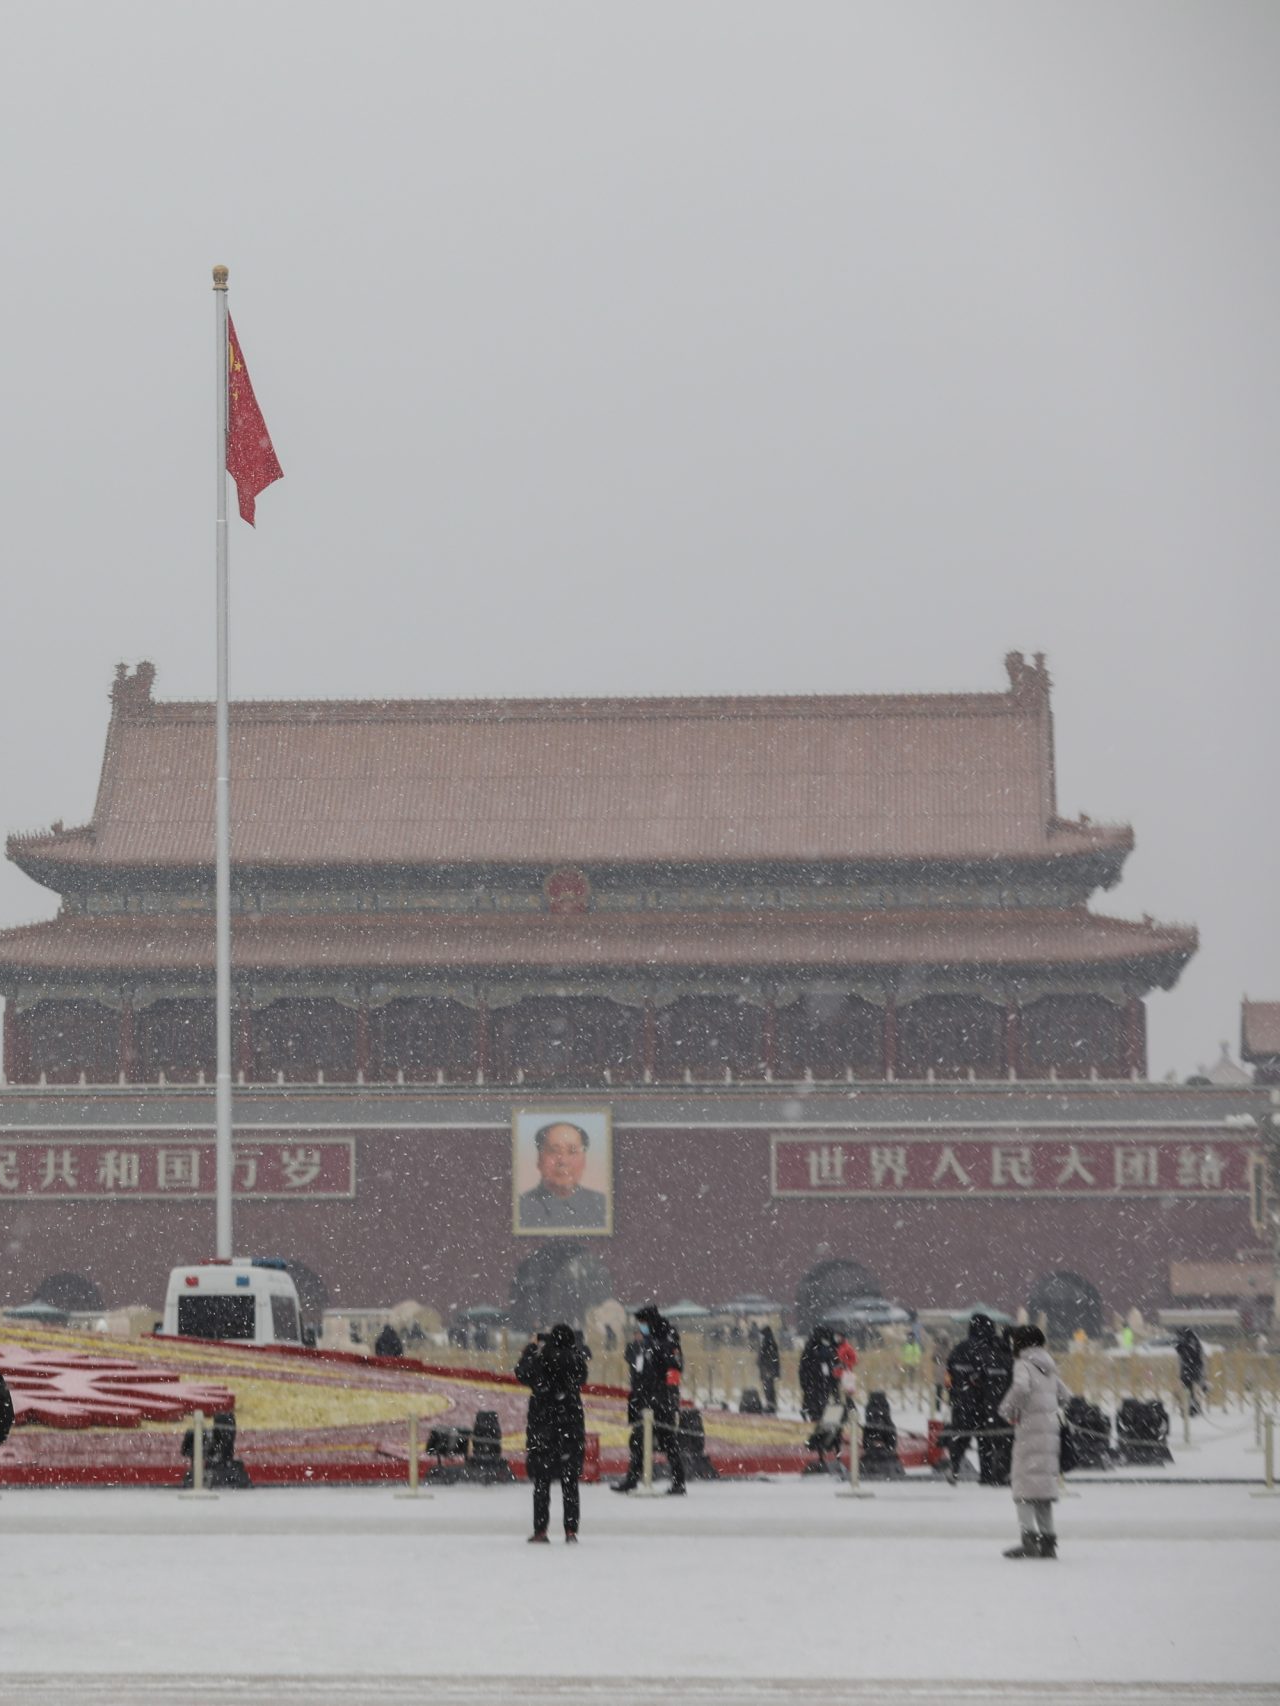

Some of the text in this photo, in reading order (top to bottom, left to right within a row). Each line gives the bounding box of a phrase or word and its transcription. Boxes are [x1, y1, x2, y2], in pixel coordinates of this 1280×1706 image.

[806, 1145, 1253, 1187] 世界人民大团结
